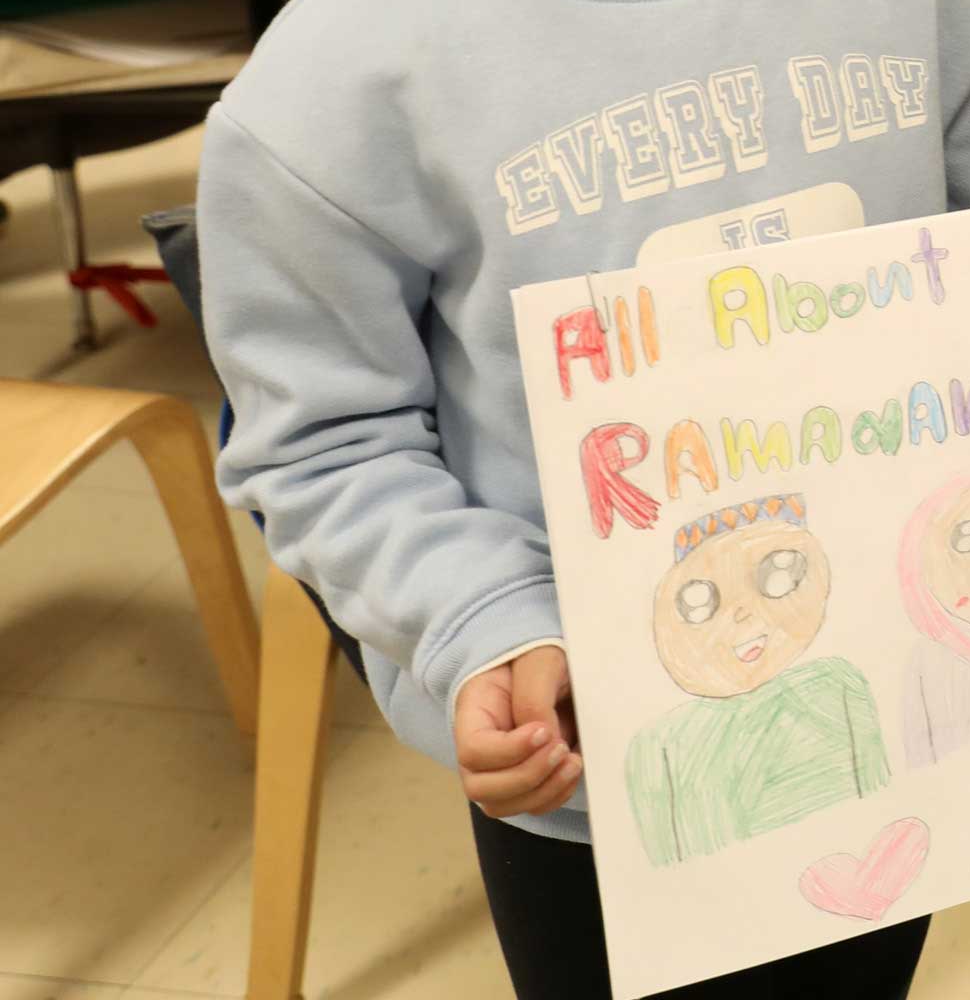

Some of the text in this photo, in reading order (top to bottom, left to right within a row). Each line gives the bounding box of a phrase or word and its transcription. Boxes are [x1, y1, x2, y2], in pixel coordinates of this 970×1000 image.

[495, 53, 928, 236] EVERY DAY
[552, 226, 950, 401] All About
